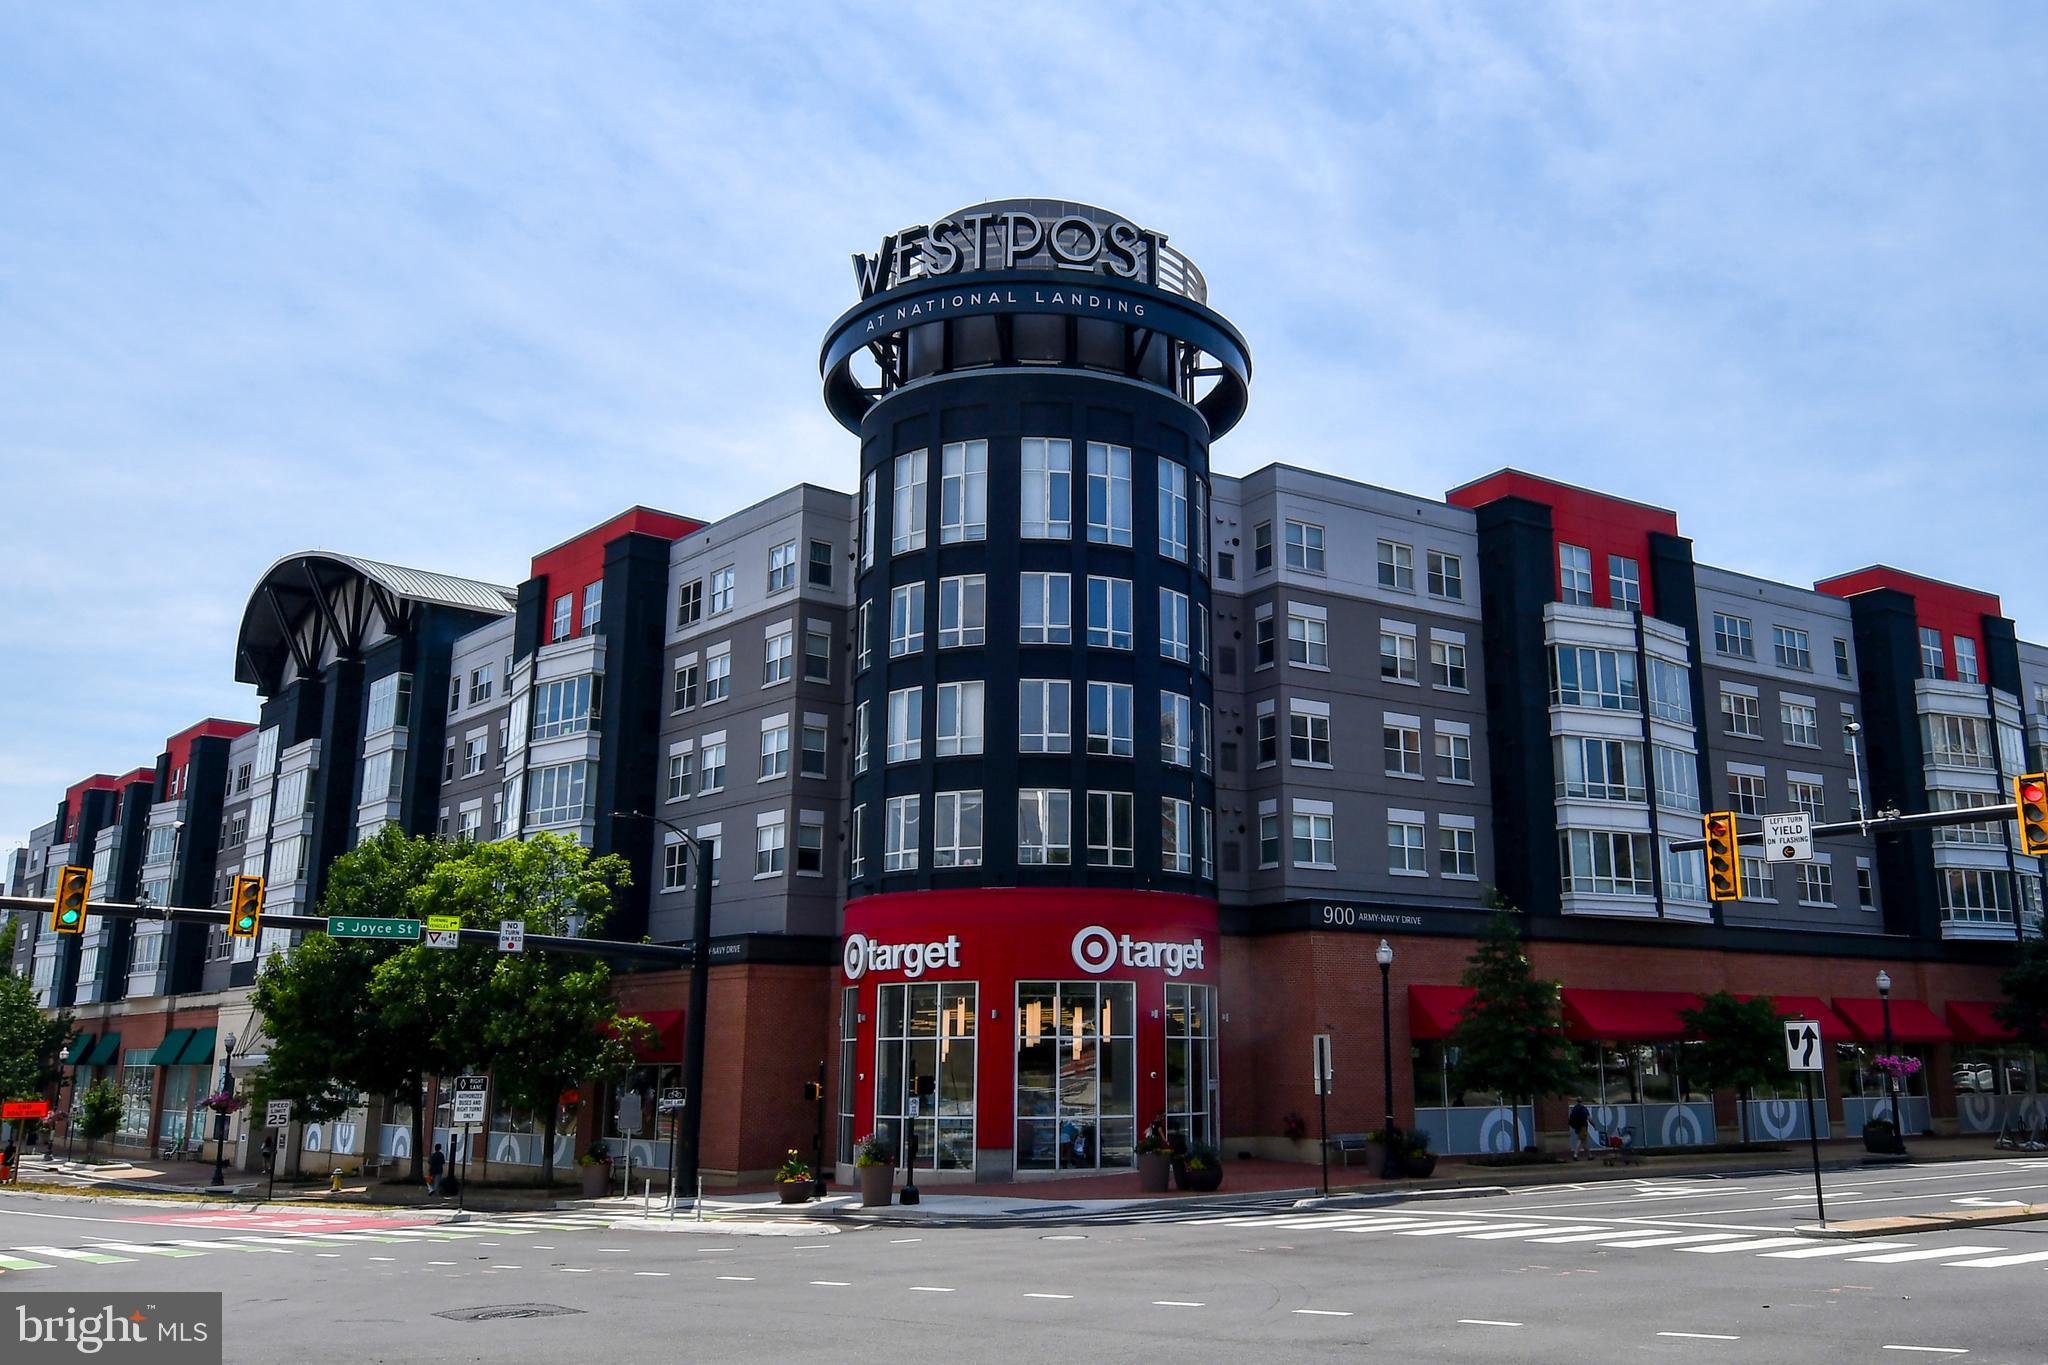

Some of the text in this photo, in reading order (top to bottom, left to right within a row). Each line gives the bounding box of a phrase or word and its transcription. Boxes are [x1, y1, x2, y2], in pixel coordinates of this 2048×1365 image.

[851, 212, 1168, 301] WESTPOST
[866, 291, 1145, 332] AT NATIONAL LANDING
[1770, 817, 1783, 825] LEFT
[1772, 825, 1803, 836] YIELD
[1780, 835, 1809, 844] FLASHING
[1323, 906, 1422, 925] 900 ARMY-NAVY DRIVE
[336, 921, 412, 934] S Joyce St
[867, 935, 960, 976] target
[1119, 935, 1204, 977] target
[268, 1114, 288, 1125] 25
